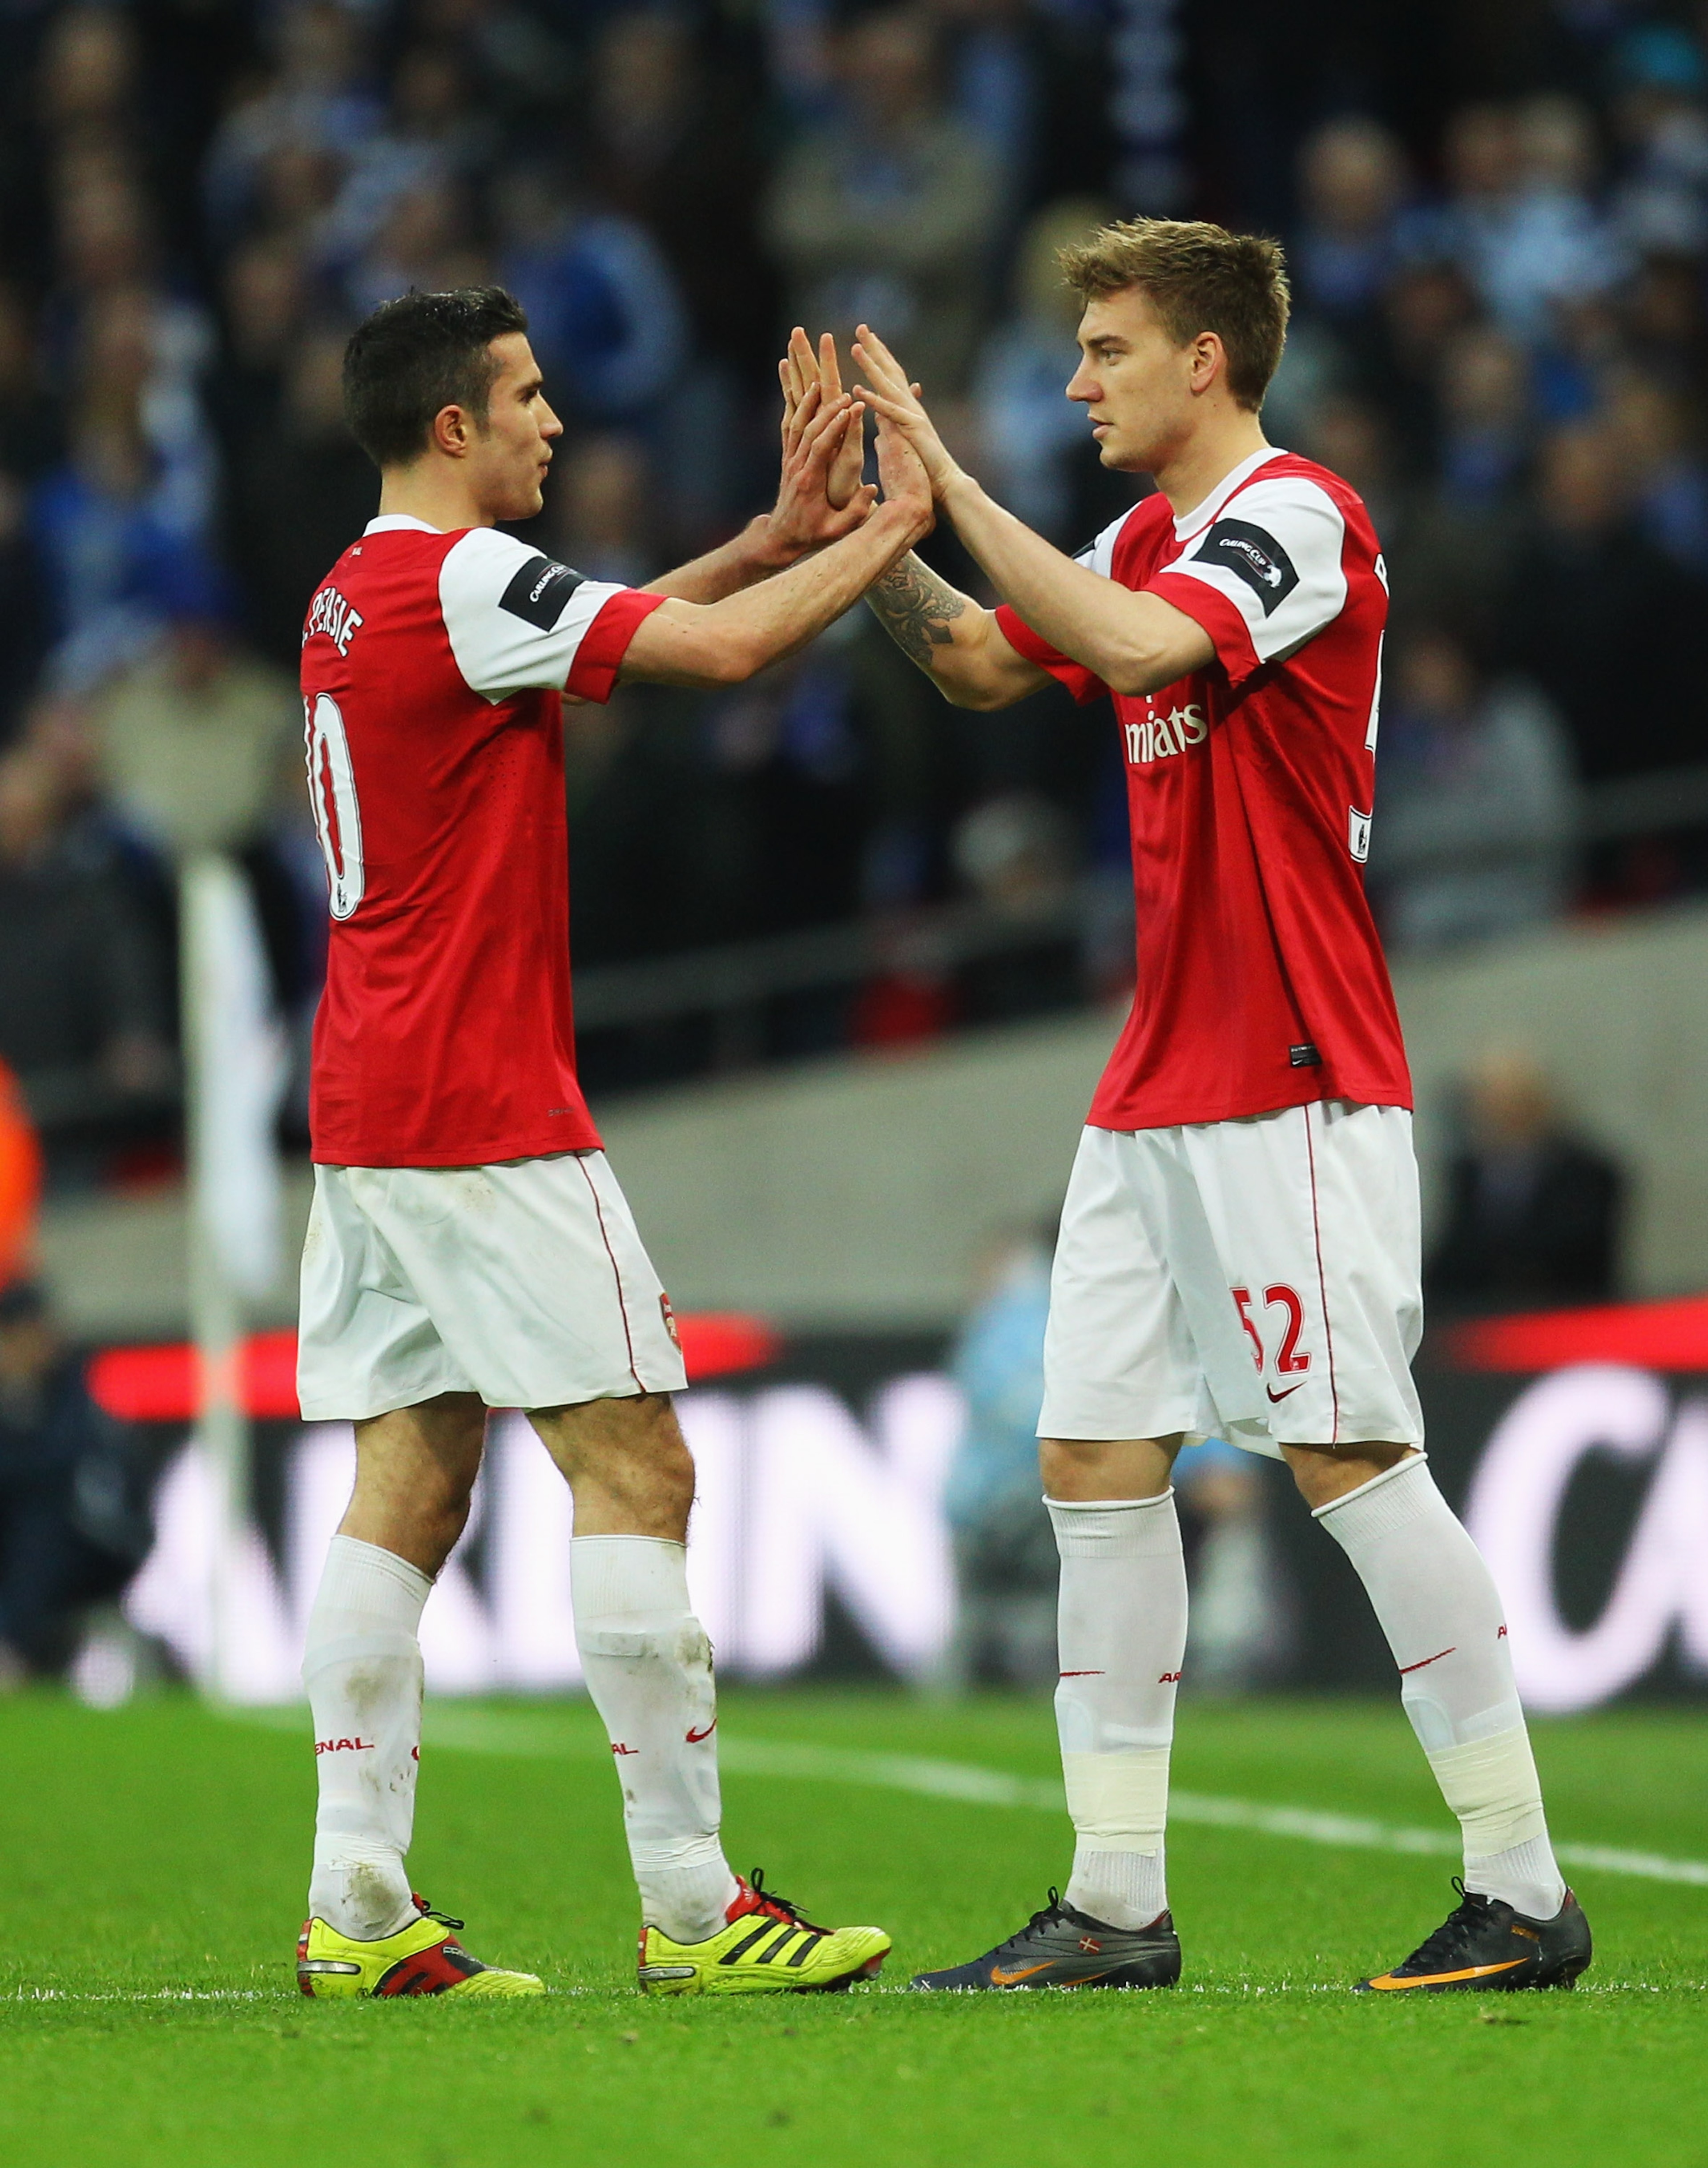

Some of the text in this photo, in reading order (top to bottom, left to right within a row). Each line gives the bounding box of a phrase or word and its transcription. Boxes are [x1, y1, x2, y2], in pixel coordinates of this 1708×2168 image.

[1250, 550, 1266, 565] CUP
[304, 692, 365, 921] 0
[1229, 1283, 1312, 1376] 52
